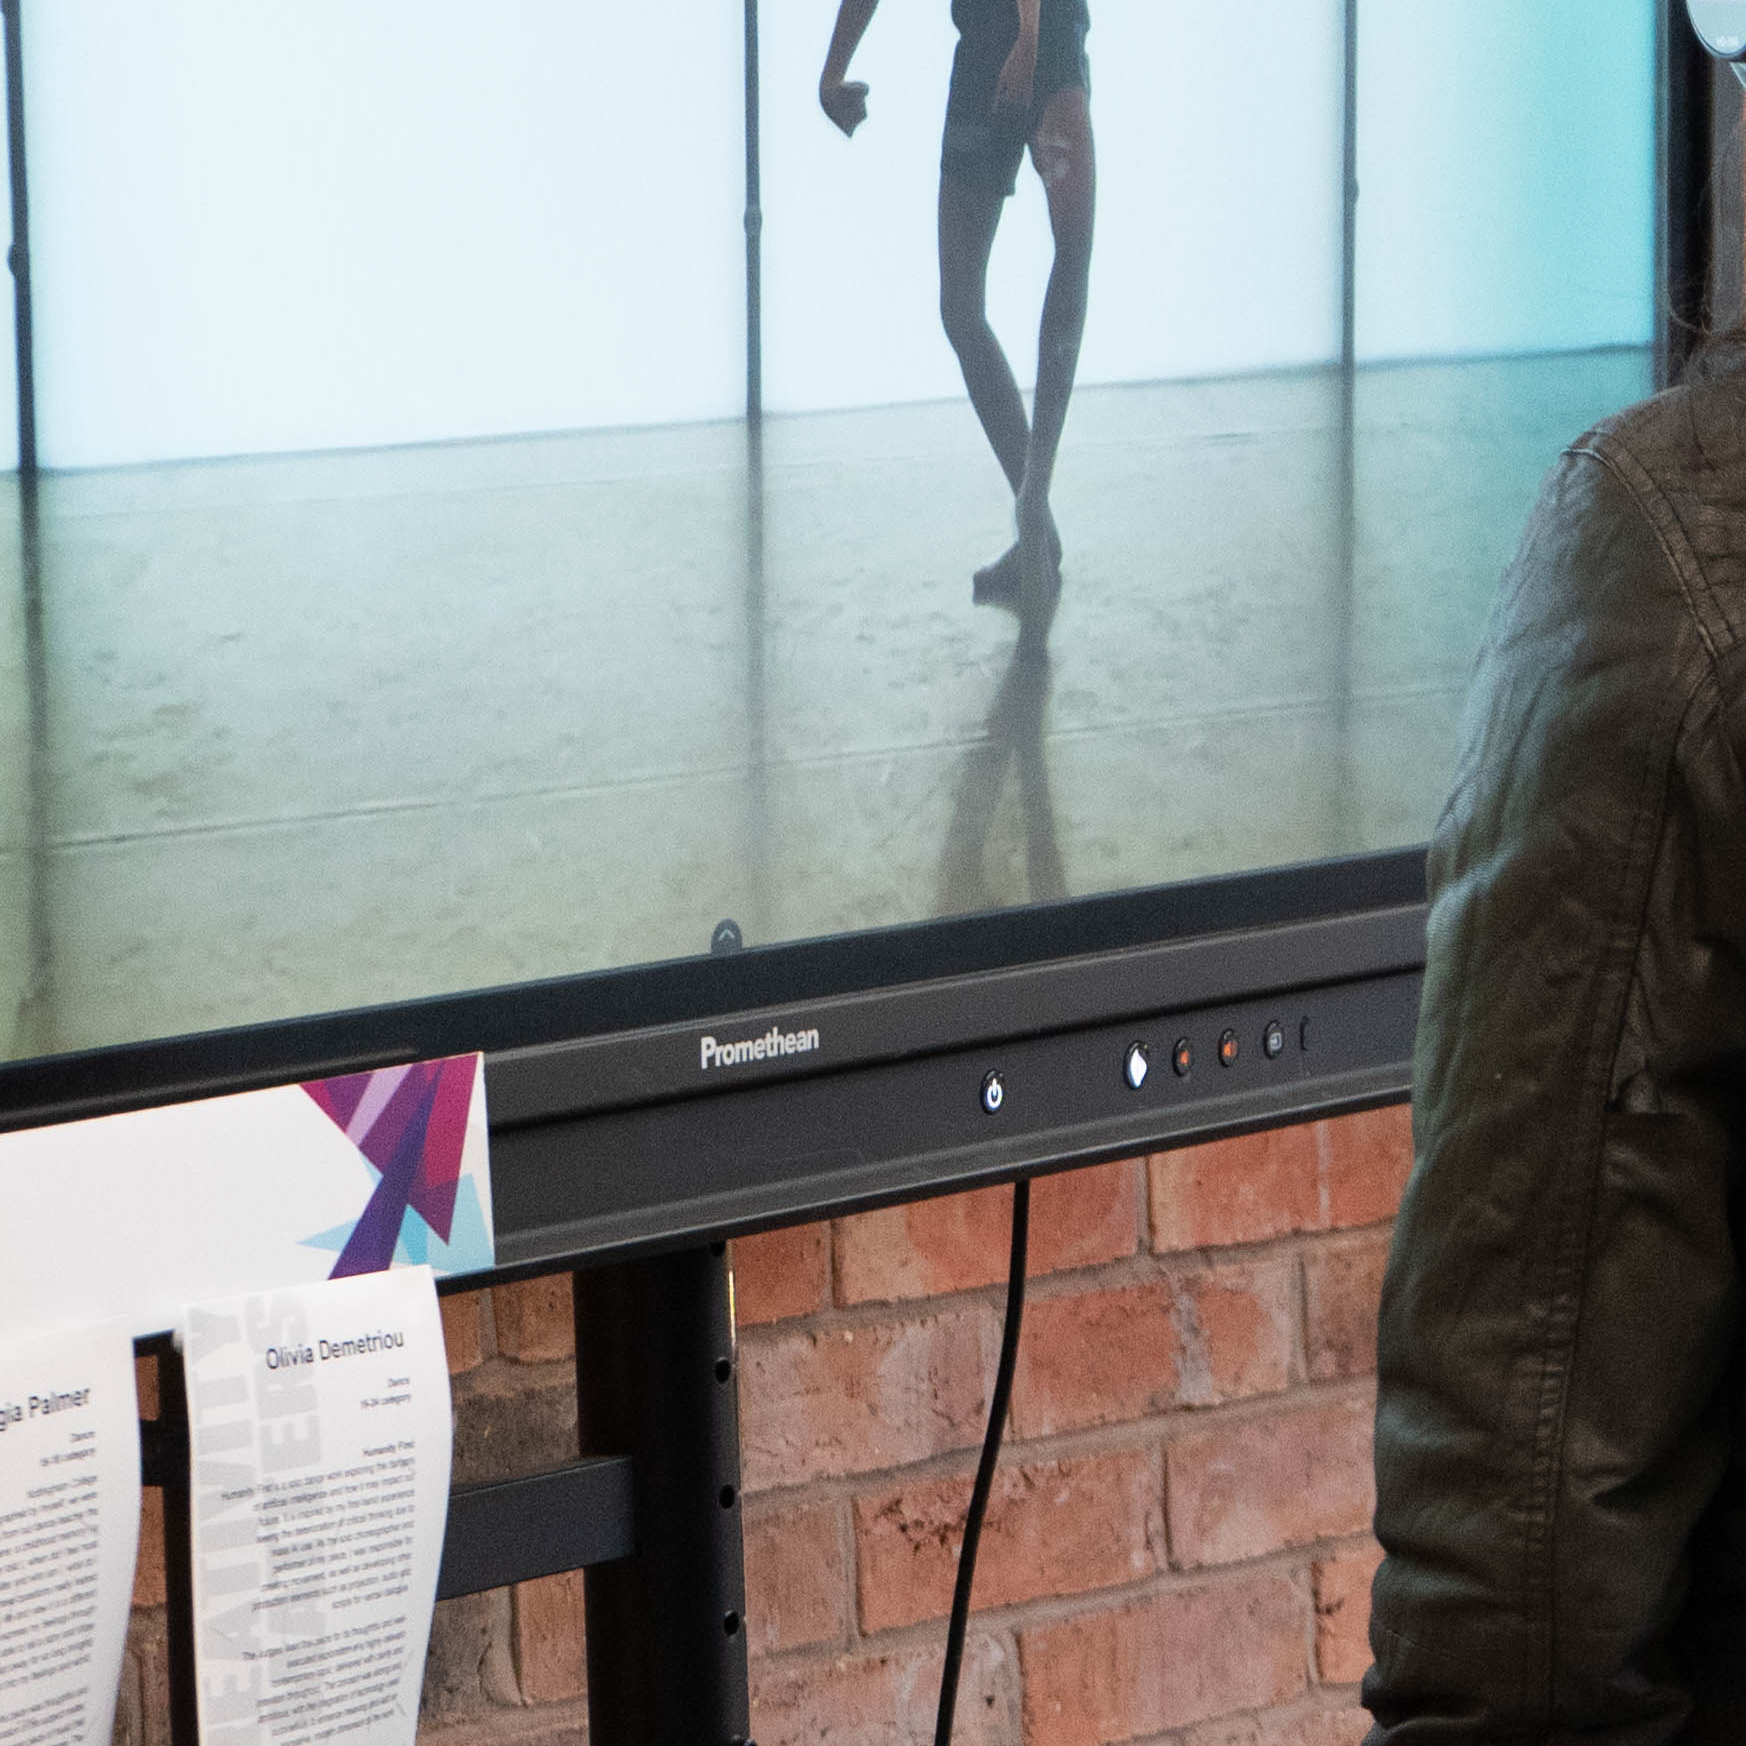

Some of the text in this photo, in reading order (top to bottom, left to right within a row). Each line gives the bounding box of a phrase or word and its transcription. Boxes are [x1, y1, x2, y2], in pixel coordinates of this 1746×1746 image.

[700, 1026, 819, 1070] Promethean
[266, 1330, 404, 1370] Olivia Demetriou
[28, 1387, 90, 1418] Palmer
